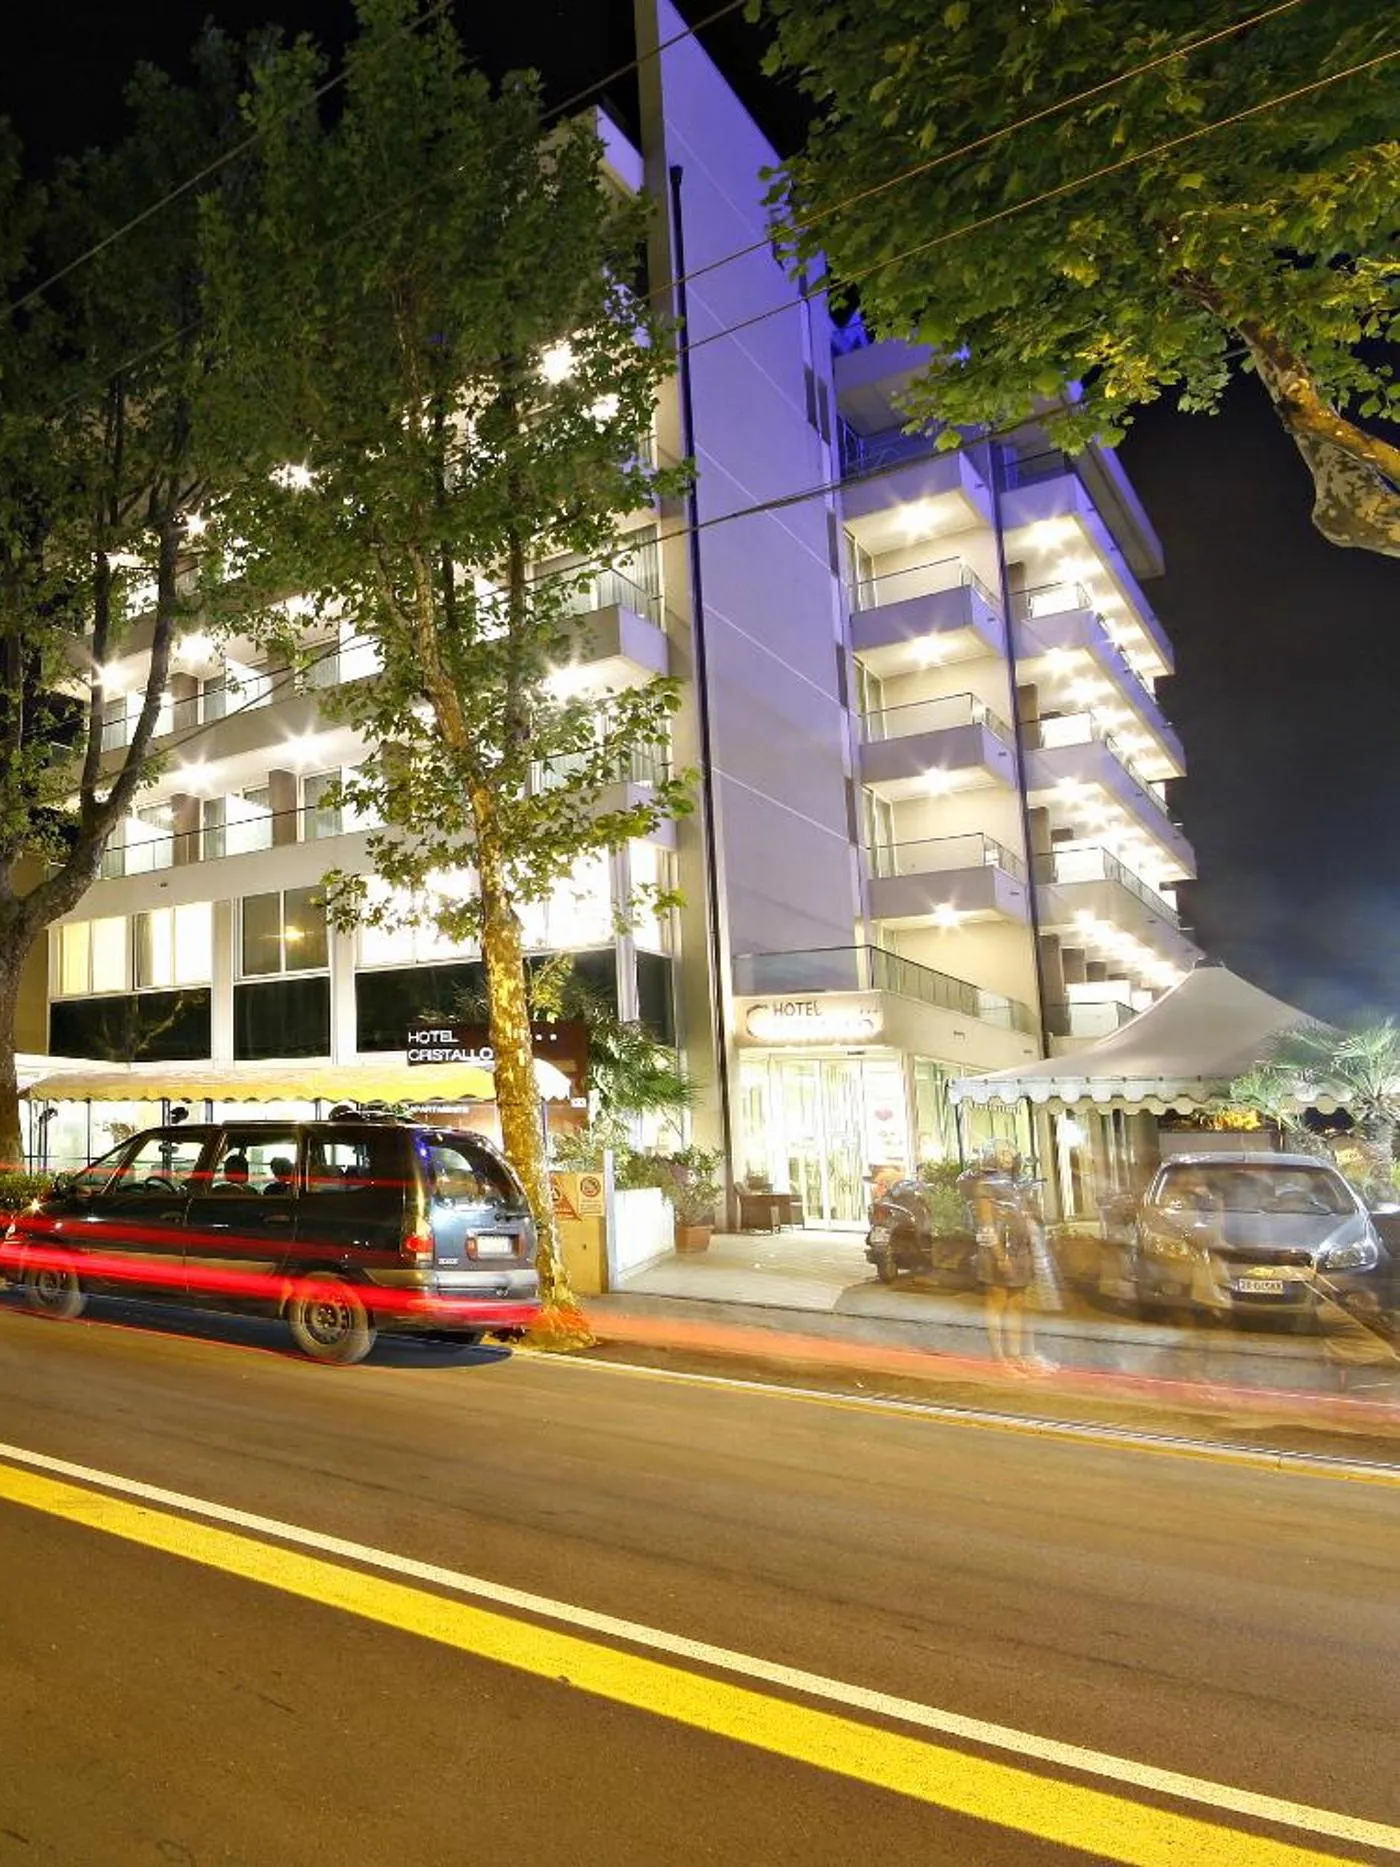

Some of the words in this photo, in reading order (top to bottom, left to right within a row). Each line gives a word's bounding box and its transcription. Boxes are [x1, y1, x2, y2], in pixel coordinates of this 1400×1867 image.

[773, 1001, 822, 1016] HOTEL
[408, 1030, 459, 1044] HOTEL
[407, 1046, 493, 1061] CRISTALLO
